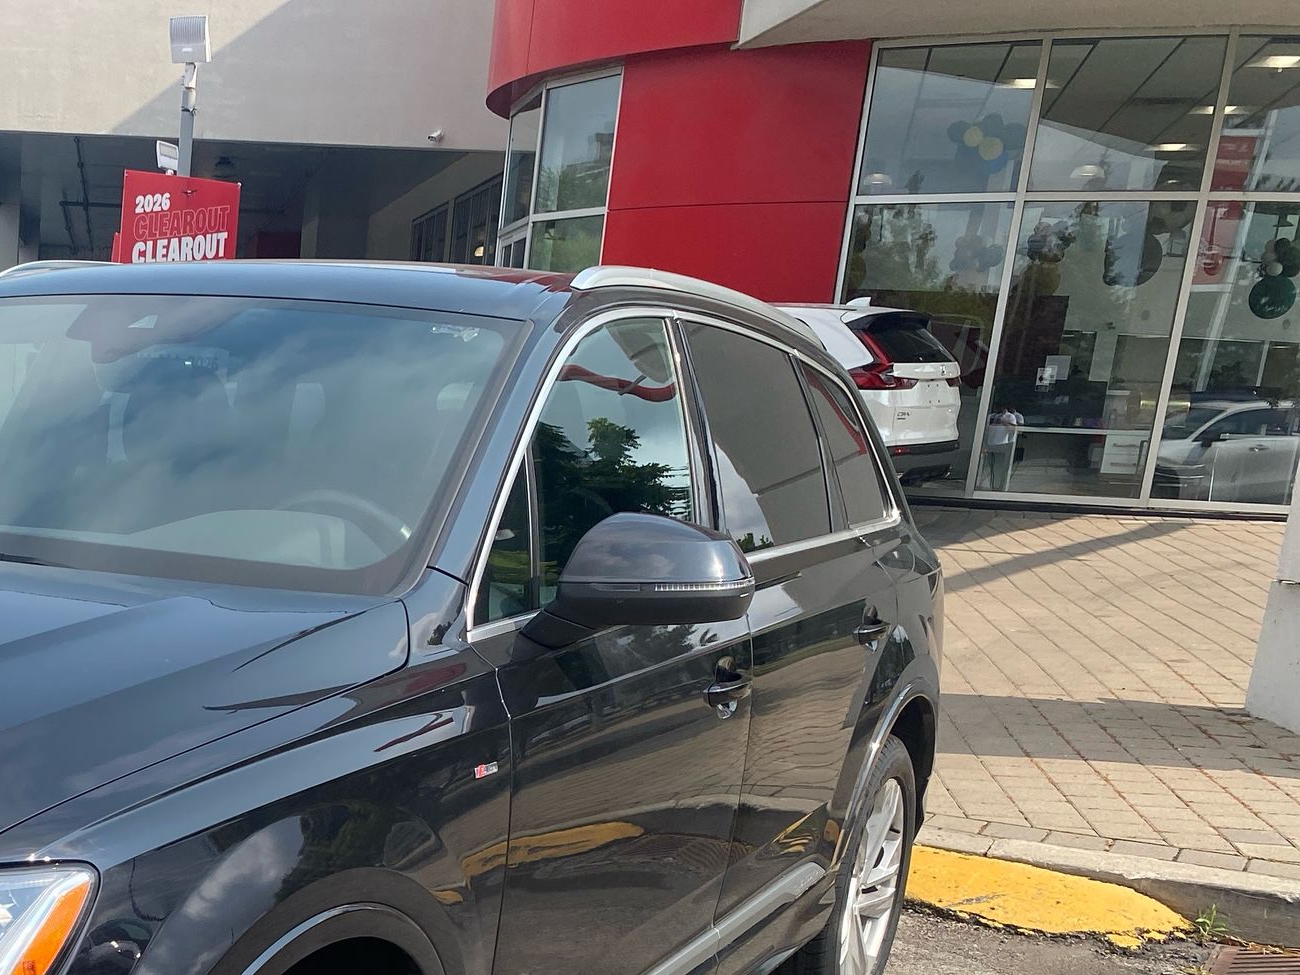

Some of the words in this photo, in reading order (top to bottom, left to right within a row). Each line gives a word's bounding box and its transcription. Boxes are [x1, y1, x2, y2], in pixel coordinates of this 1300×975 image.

[134, 192, 171, 214] 2026
[133, 205, 231, 241] CLEAROUT
[131, 232, 229, 264] CLEAROUT
